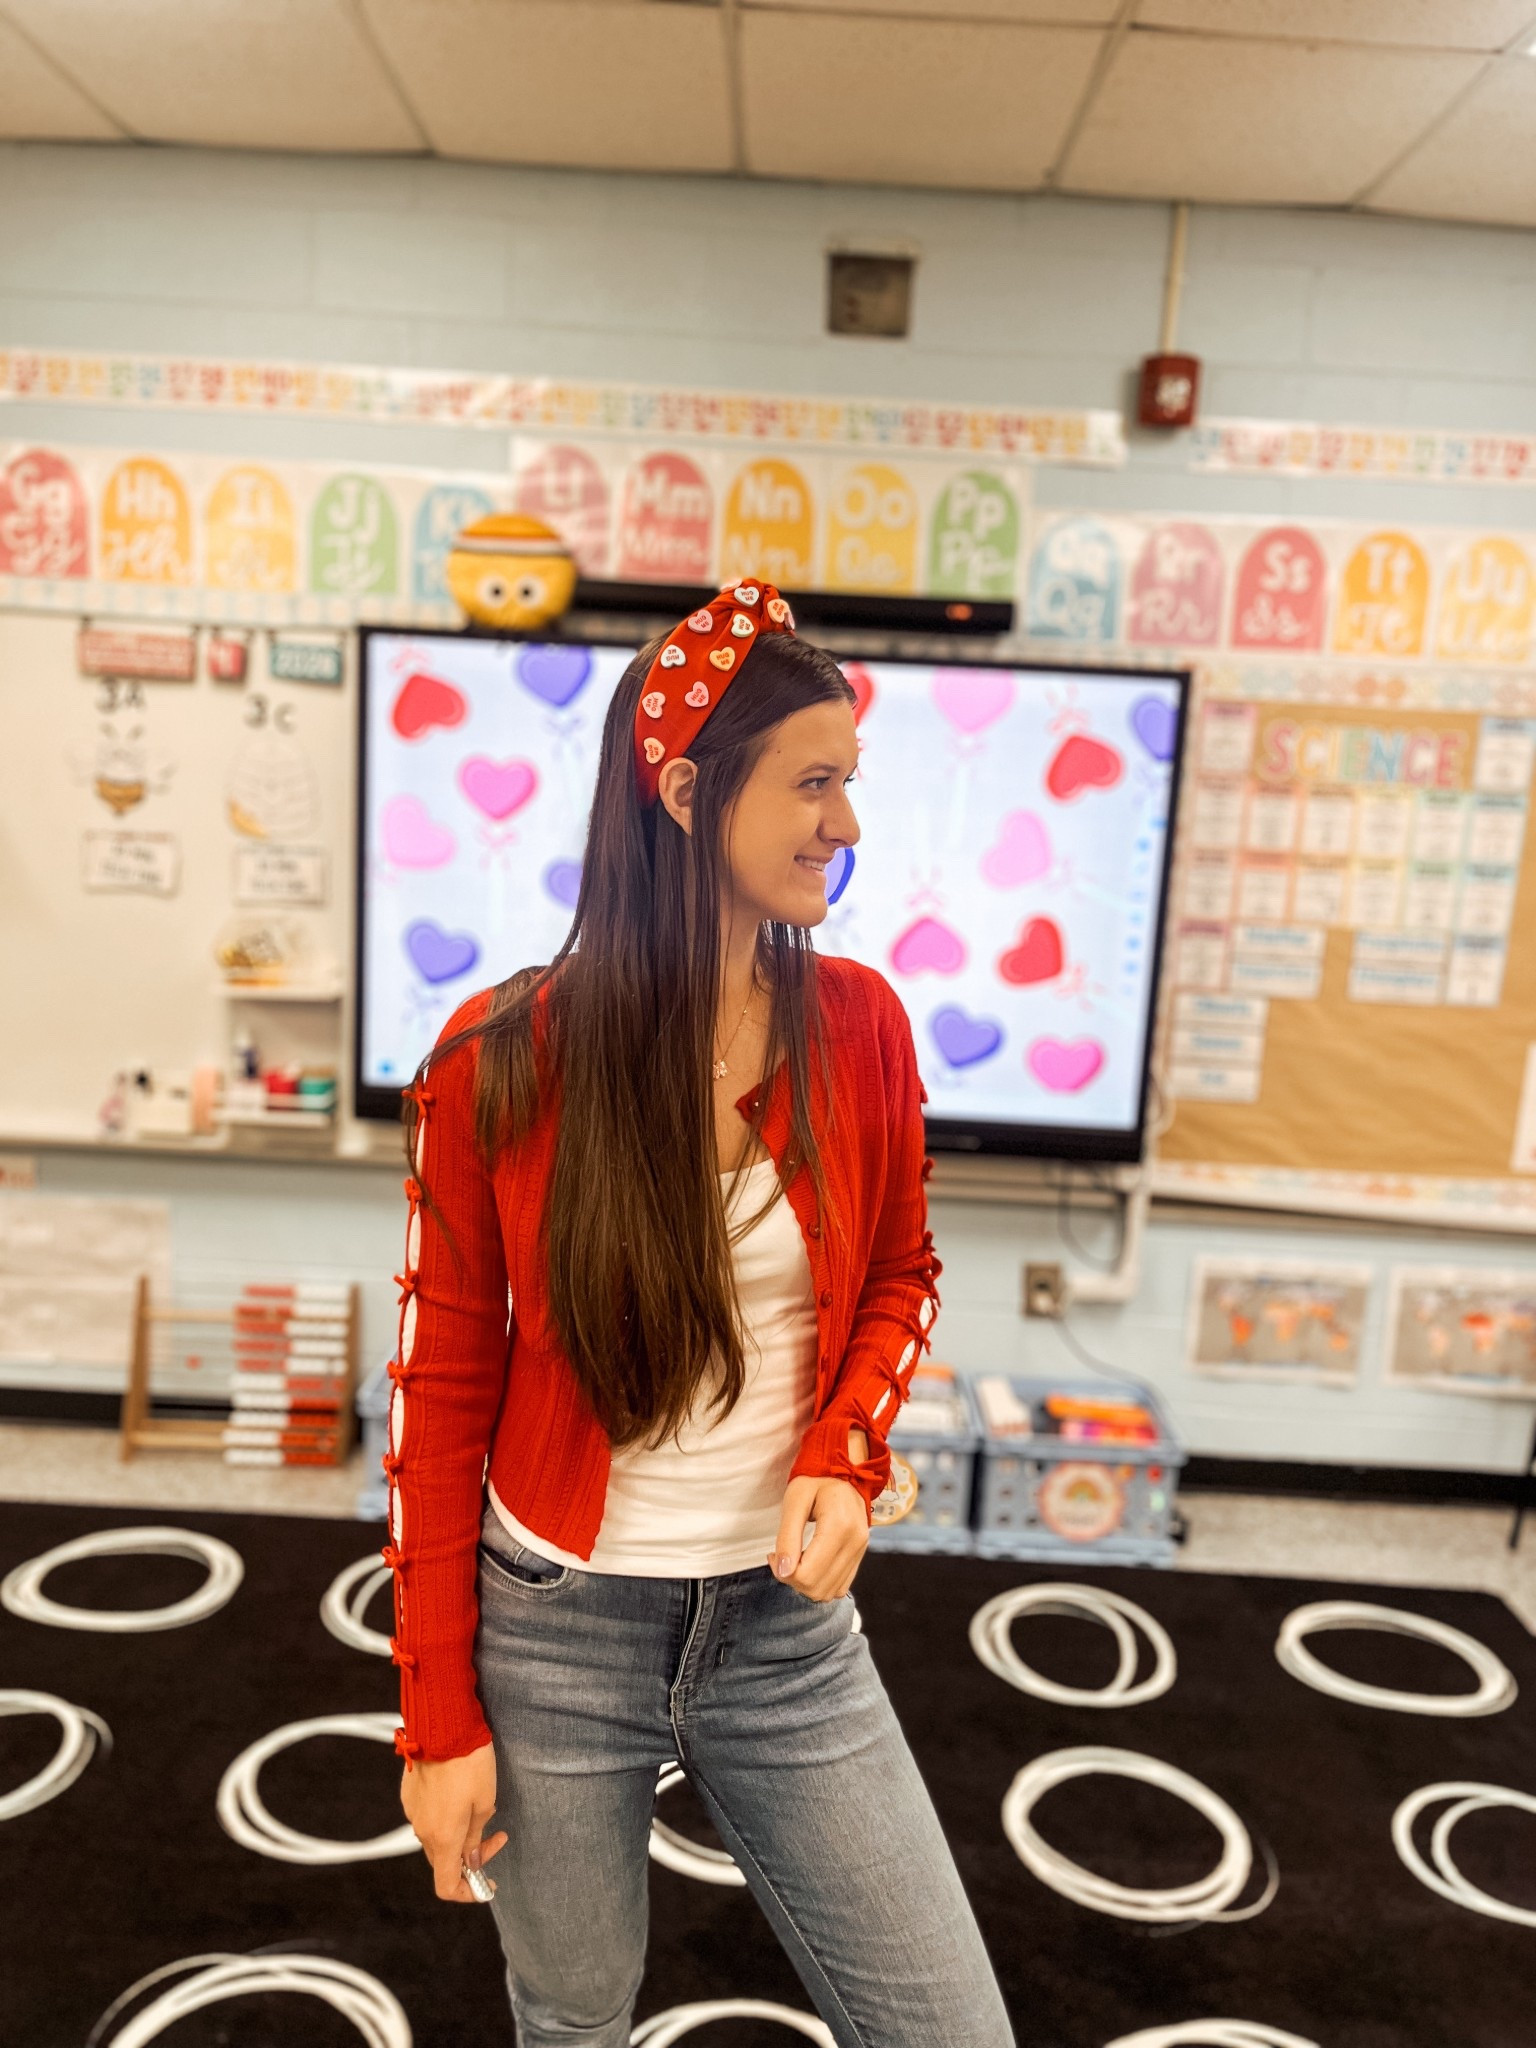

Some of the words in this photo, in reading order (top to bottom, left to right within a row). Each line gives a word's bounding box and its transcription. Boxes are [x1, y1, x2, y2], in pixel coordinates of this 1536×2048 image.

[740, 471, 801, 521] Nn
[836, 474, 911, 530] Oo
[948, 475, 1006, 541] Pp
[1260, 539, 1310, 594] Ss
[695, 615, 706, 626] HUG
[716, 652, 729, 660] HUG
[651, 697, 659, 711] HUG
[691, 688, 702, 701] HUG
[1262, 721, 1462, 788] SCIENCE
